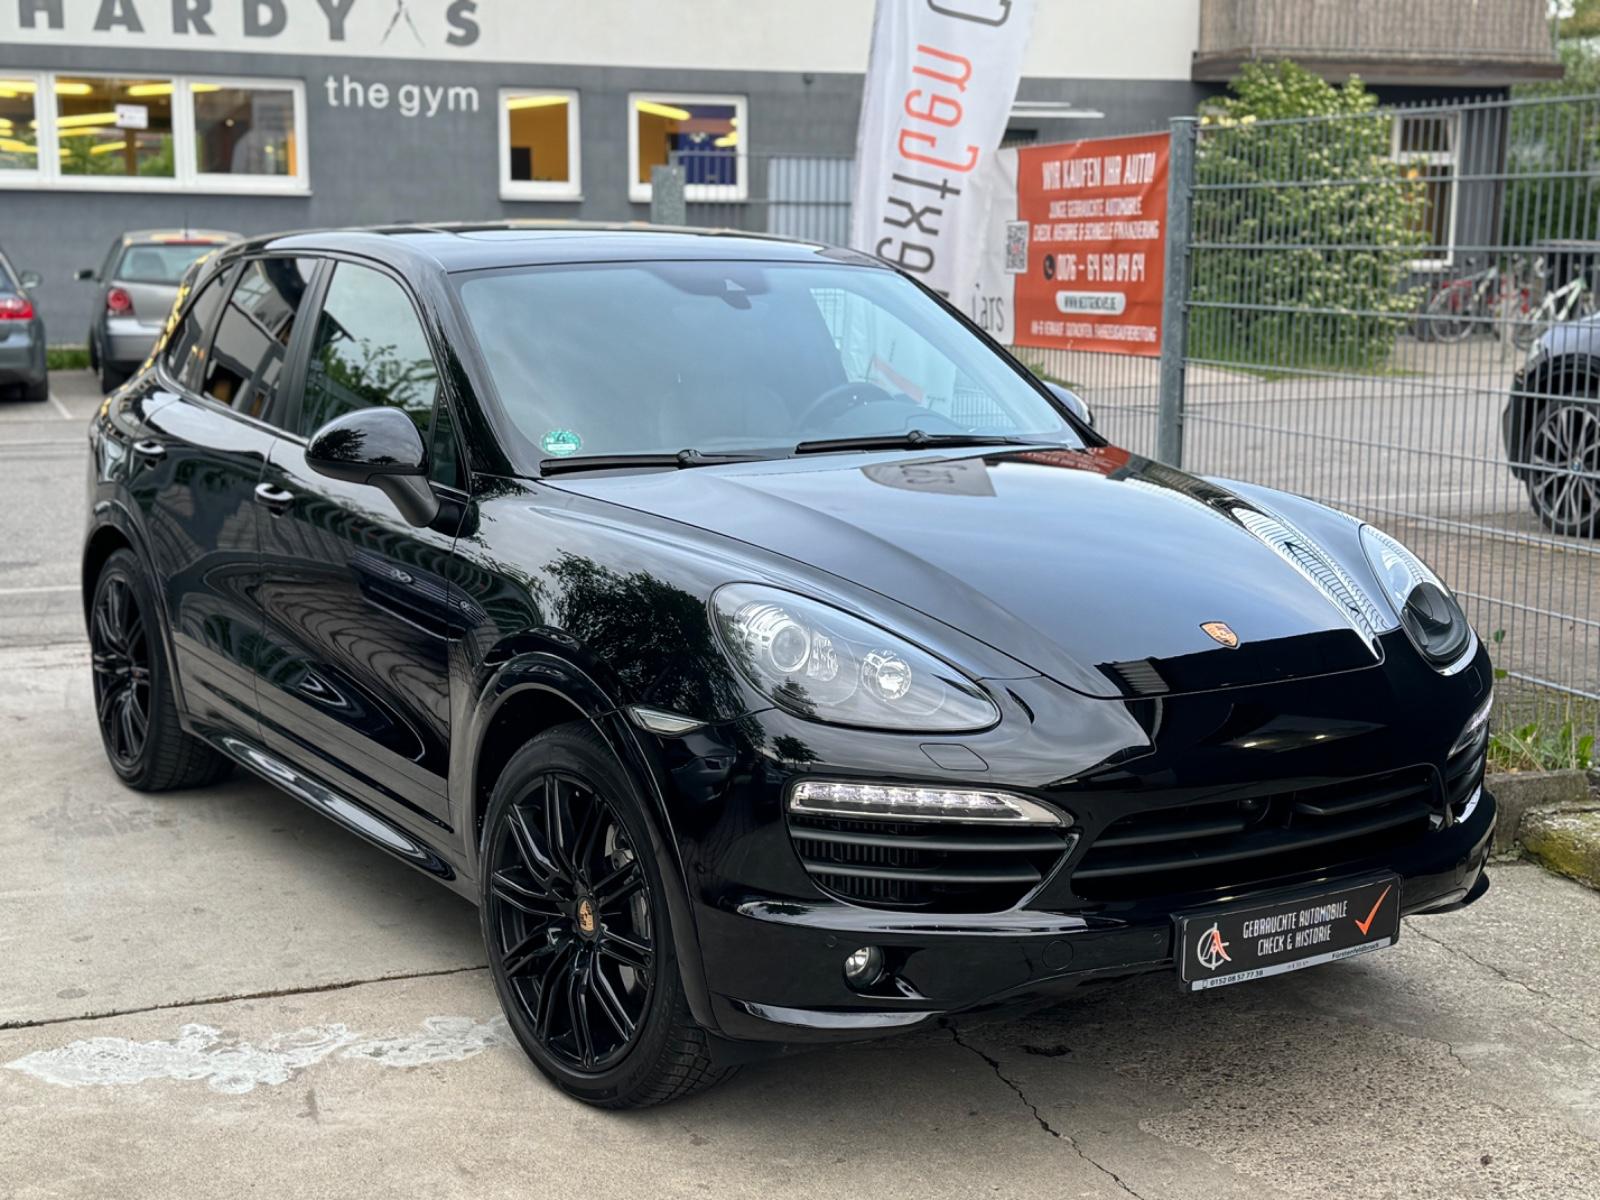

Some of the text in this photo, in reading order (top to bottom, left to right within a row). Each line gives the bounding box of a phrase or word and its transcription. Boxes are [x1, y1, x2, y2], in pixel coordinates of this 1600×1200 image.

[325, 75, 479, 117] the gym
[1042, 161, 1060, 190] WIR
[1063, 157, 1102, 189] KAUFEN
[1103, 155, 1121, 186] IHR
[1243, 900, 1348, 939] GEBRAUCHTE AUTOMOBILE
[1257, 933, 1285, 956] CHECK
[1295, 924, 1332, 949] HISTORIE
